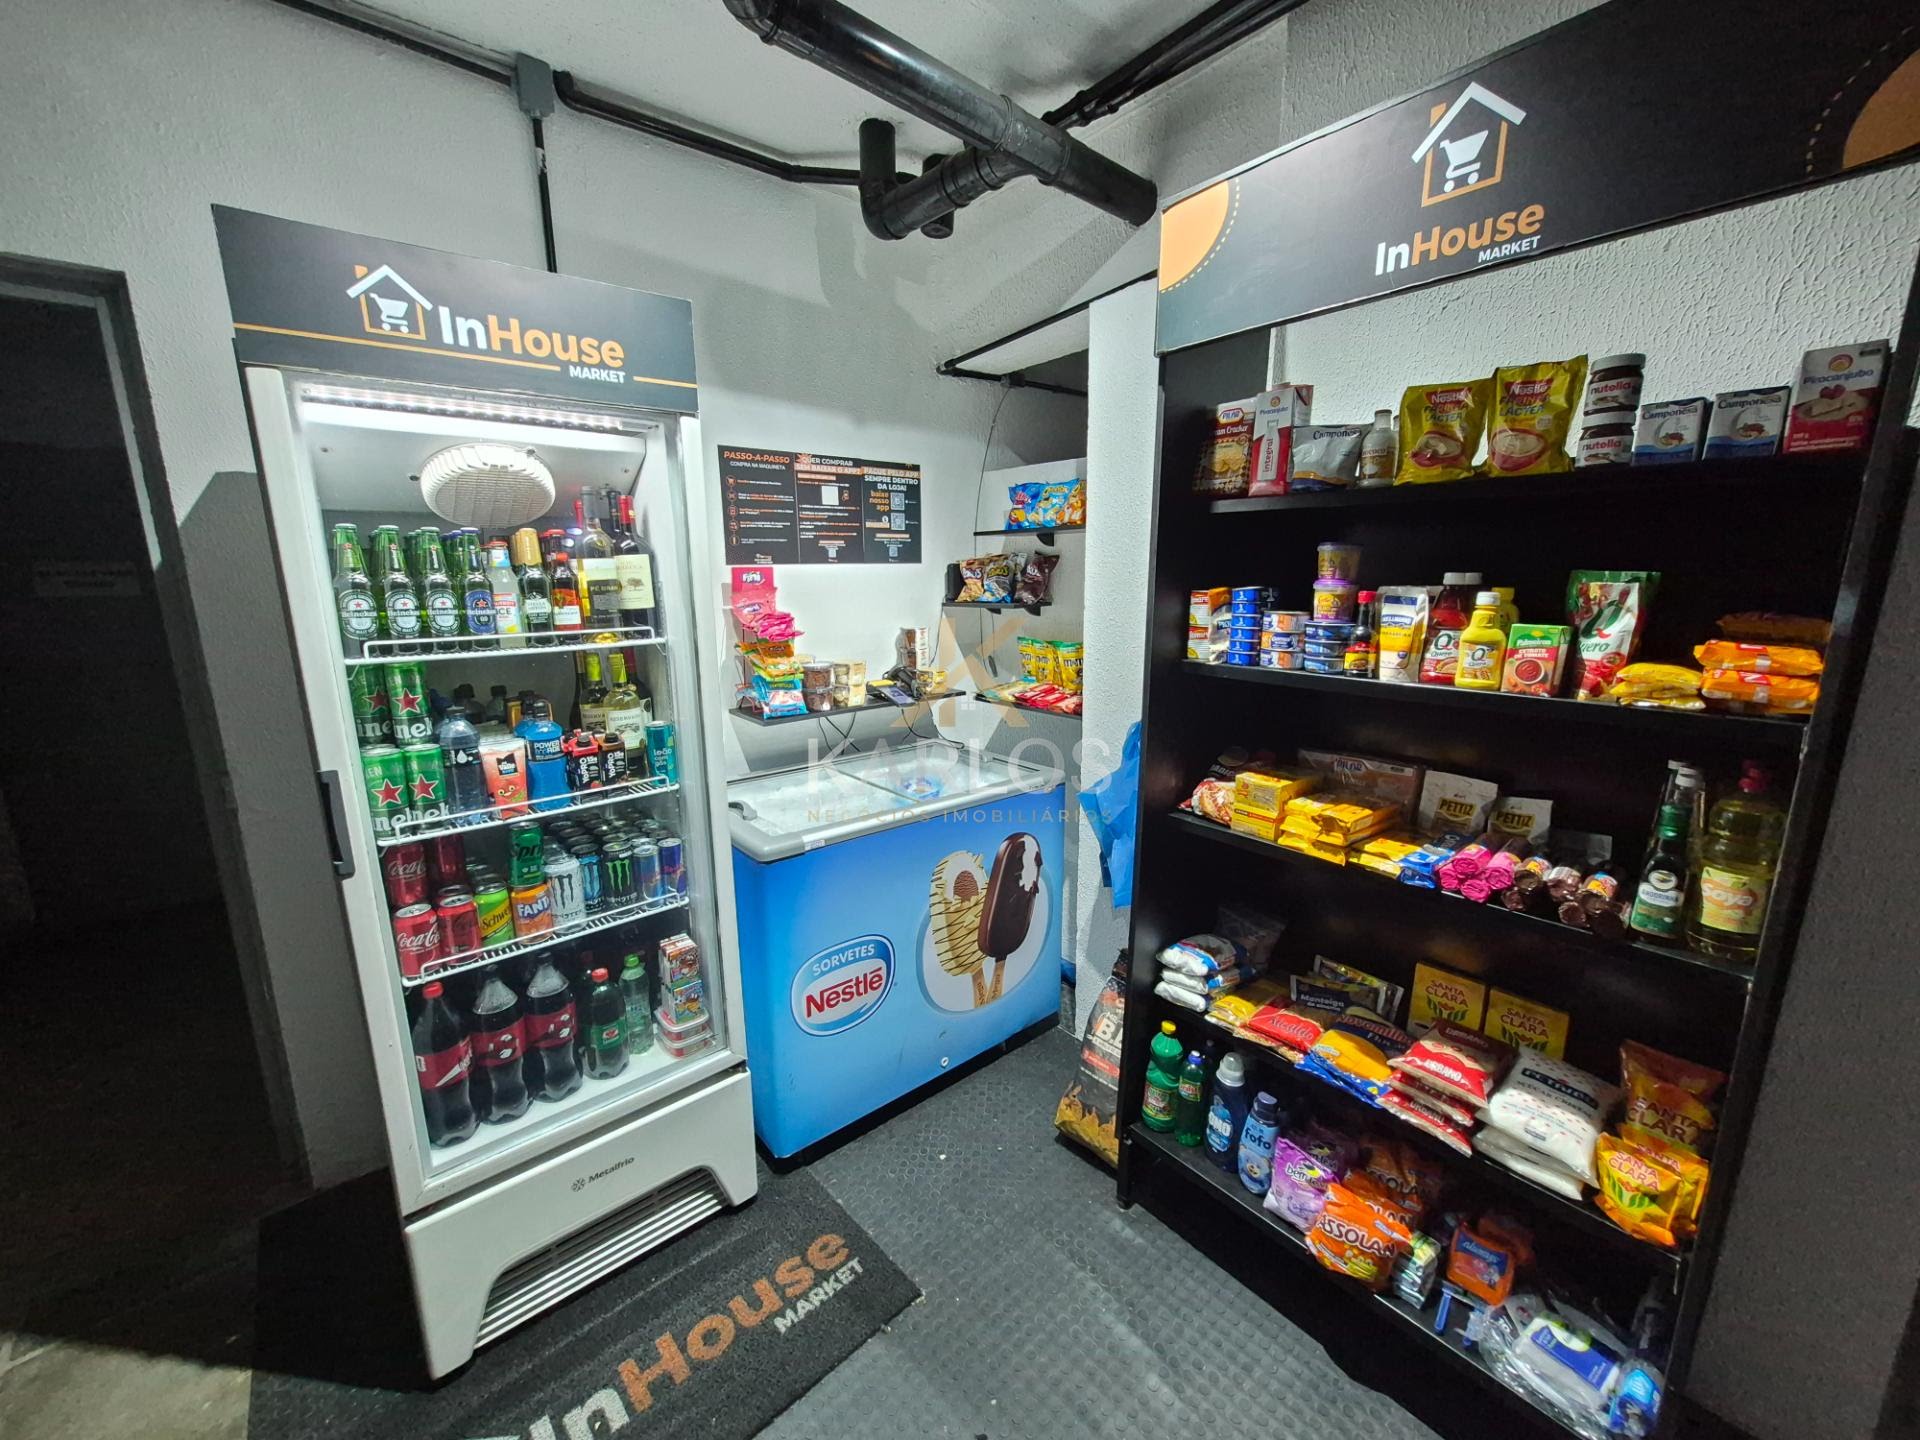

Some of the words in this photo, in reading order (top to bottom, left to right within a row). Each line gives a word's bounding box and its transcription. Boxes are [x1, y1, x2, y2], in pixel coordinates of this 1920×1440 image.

[1375, 203, 1544, 276] InHouse
[1478, 235, 1541, 263] MARKET
[438, 306, 626, 367] InHouse
[568, 365, 625, 384] MARKET
[1803, 368, 1874, 385] Piracanjuba
[1591, 381, 1631, 395] nutella
[1642, 406, 1698, 420] Camponesa
[1718, 394, 1781, 410] Camponesa
[1263, 438, 1274, 473] integral
[1582, 439, 1622, 452] nutella
[724, 451, 790, 464] PASSO-A-PASSO
[821, 458, 853, 466] COMPRAR
[864, 475, 892, 483] SEMPRE
[892, 476, 919, 485] DENTRO
[1578, 640, 1609, 653] uero
[534, 742, 560, 751] POWER
[1439, 799, 1475, 817] PETTIZ
[1496, 811, 1533, 828] PETTIZ
[812, 943, 875, 976] SORVETES
[804, 966, 883, 1018] Nestlé
[1425, 986, 1469, 1008] CLARA
[1431, 979, 1466, 998] SANTA
[1500, 1014, 1549, 1037] CLARA
[1507, 1007, 1546, 1027] SANTA
[1634, 1096, 1699, 1128] SANTA
[1244, 1127, 1273, 1151] fofo
[588, 1156, 635, 1184] Metalfrio
[1609, 1159, 1660, 1192] CLARA
[1614, 1151, 1659, 1179] SANTA
[1318, 1214, 1396, 1257] ASSOLAN
[773, 1256, 864, 1335] MARKET
[529, 1234, 849, 1440] InHouse
